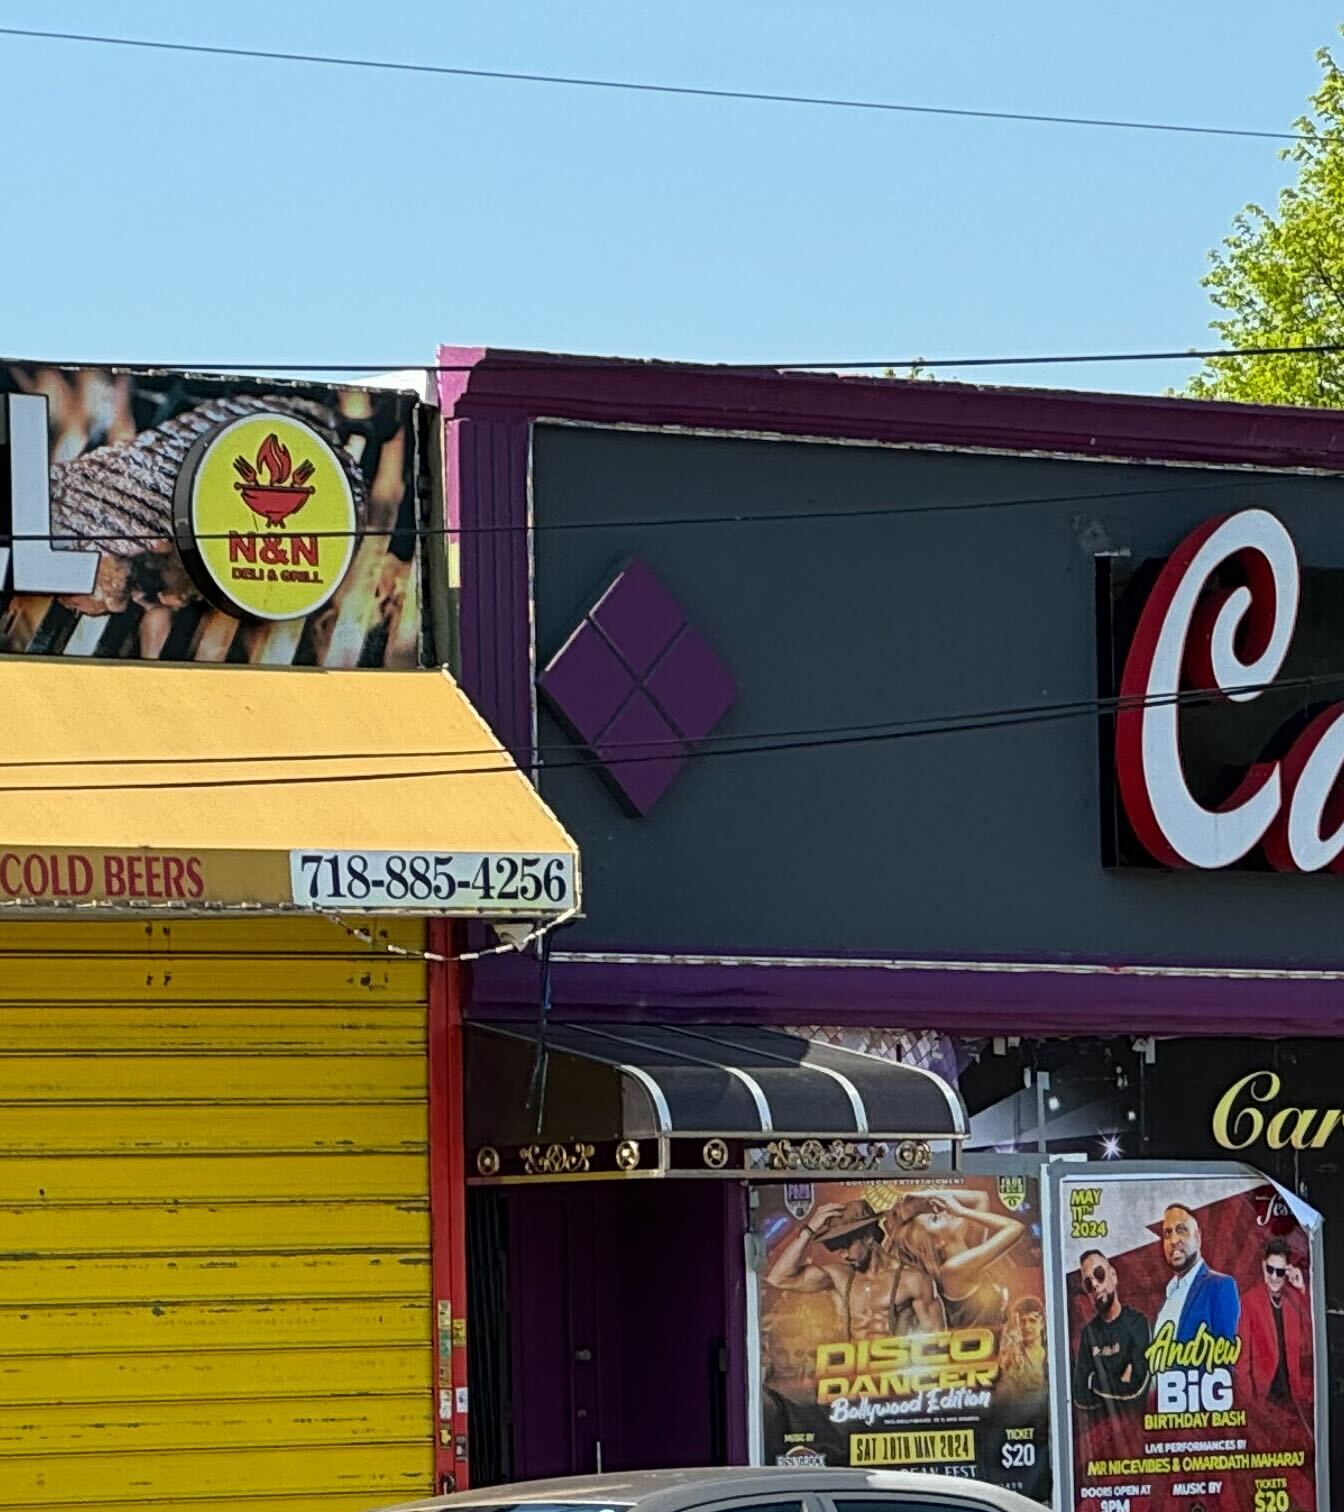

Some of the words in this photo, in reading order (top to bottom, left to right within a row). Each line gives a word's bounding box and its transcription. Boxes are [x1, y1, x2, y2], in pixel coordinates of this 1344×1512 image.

[229, 531, 319, 567] N&N
[232, 567, 264, 581] DELI
[280, 570, 324, 584] GRILL
[0, 853, 93, 897] COLD
[104, 855, 205, 899] BEERS
[301, 854, 567, 902] 718-885-4256
[1070, 1189, 1103, 1206] MAY
[1072, 1222, 1108, 1238] 2024
[816, 1328, 994, 1377] DISCO
[1144, 1320, 1243, 1374] Andrew
[817, 1361, 1000, 1405] DANCER
[1157, 1368, 1234, 1414] BiG
[829, 1390, 922, 1426] Bollywood
[926, 1387, 991, 1413] Edition
[1144, 1413, 1210, 1430] BIRTHDAY
[1212, 1411, 1246, 1427] BASH
[856, 1437, 878, 1462] SAT
[913, 1434, 937, 1459] MAY
[939, 1433, 969, 1458] 2024
[1005, 1428, 1035, 1441] TICKET
[1145, 1442, 1164, 1454] LIVE
[1165, 1440, 1236, 1453] PERFORMANCES
[1237, 1439, 1247, 1450] BY
[1001, 1443, 1036, 1470] $20
[1087, 1461, 1108, 1476] MR
[1108, 1457, 1171, 1475] NICEVIBES
[1172, 1456, 1180, 1472] &
[1182, 1454, 1250, 1472] OMARDATH
[1251, 1451, 1305, 1469] MAHARAJ
[1081, 1486, 1113, 1498] DOORS
[1114, 1485, 1140, 1497] OPEN
[1141, 1484, 1152, 1495] AT
[1172, 1482, 1207, 1496] MUSIC
[1208, 1481, 1223, 1495] BY
[1255, 1478, 1287, 1489] TICKETS
